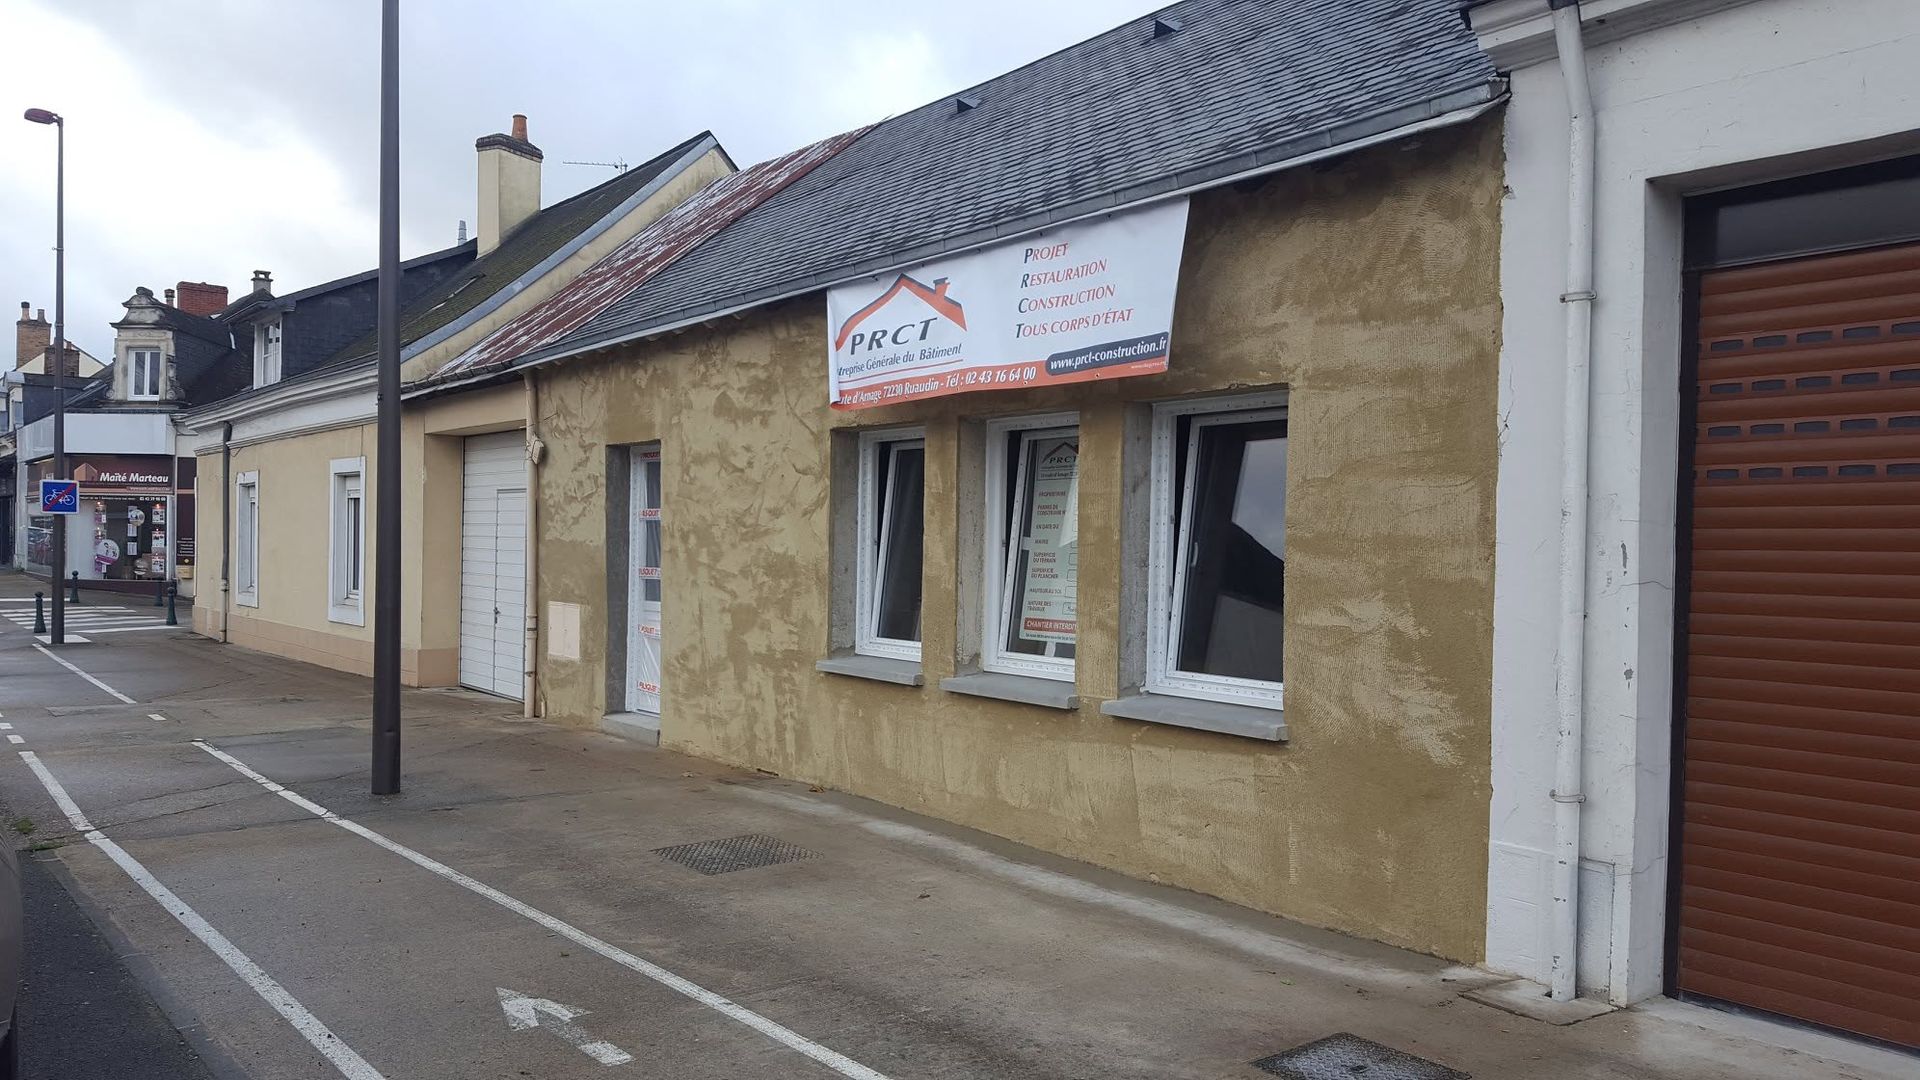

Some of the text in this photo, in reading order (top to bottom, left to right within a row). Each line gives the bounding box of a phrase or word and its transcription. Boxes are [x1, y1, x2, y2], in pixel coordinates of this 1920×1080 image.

[1023, 243, 1069, 264] PROJET
[1020, 259, 1108, 288] RESTAURATION
[1018, 284, 1116, 314] CONSTRUCTION
[850, 317, 938, 356] PRCT
[1016, 308, 1134, 339] TOUS CORPS D'ÉTAT
[865, 354, 901, 371] Générale
[902, 351, 915, 364] du
[919, 343, 962, 361] Bâtiment
[1049, 337, 1168, 370] www.prct-construction.fr
[883, 385, 903, 399] 72230
[904, 378, 939, 395] Ruaudin
[965, 372, 977, 385] 02
[979, 370, 992, 384] 43
[996, 369, 1007, 382] 16
[1008, 368, 1021, 381] 64
[1023, 367, 1037, 380] 00
[100, 472, 169, 483] Maïté Marteau
[1026, 620, 1053, 629] CHANTIER
